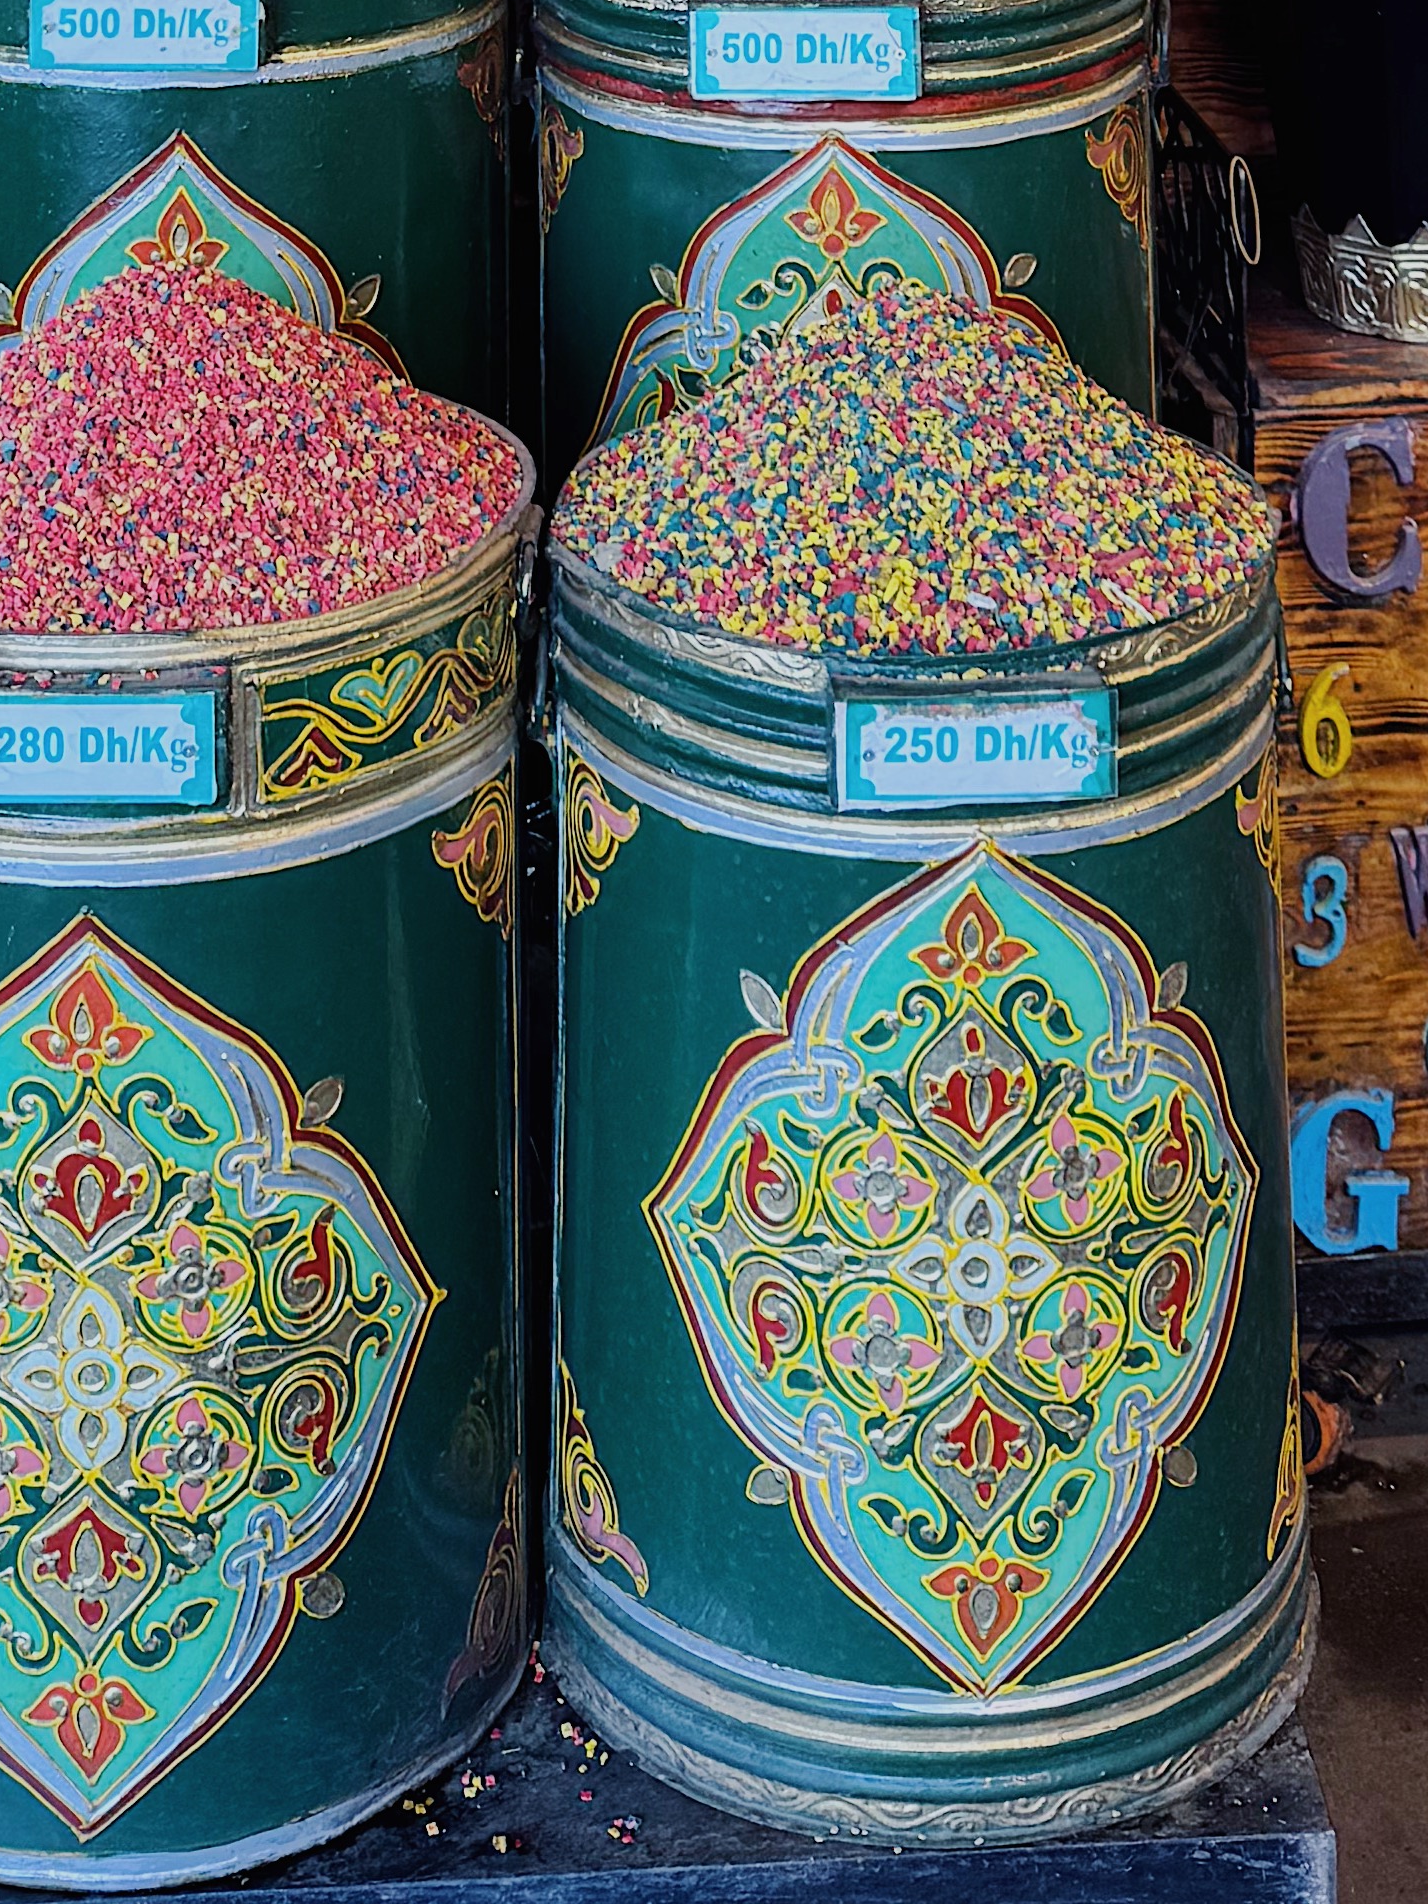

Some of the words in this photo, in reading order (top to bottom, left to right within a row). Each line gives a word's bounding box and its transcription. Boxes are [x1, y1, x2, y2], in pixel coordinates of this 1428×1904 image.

[57, 7, 121, 39] 500
[133, 7, 230, 48] Dh/Kg
[721, 32, 784, 64] 500
[795, 32, 891, 74] Dh/Kg
[1294, 417, 1424, 596] C
[1298, 661, 1353, 778] 6
[78, 725, 192, 774] Dh/Kg
[883, 725, 960, 764] 250
[974, 722, 1090, 770] Dh/Kg
[1290, 1088, 1410, 1256] G
